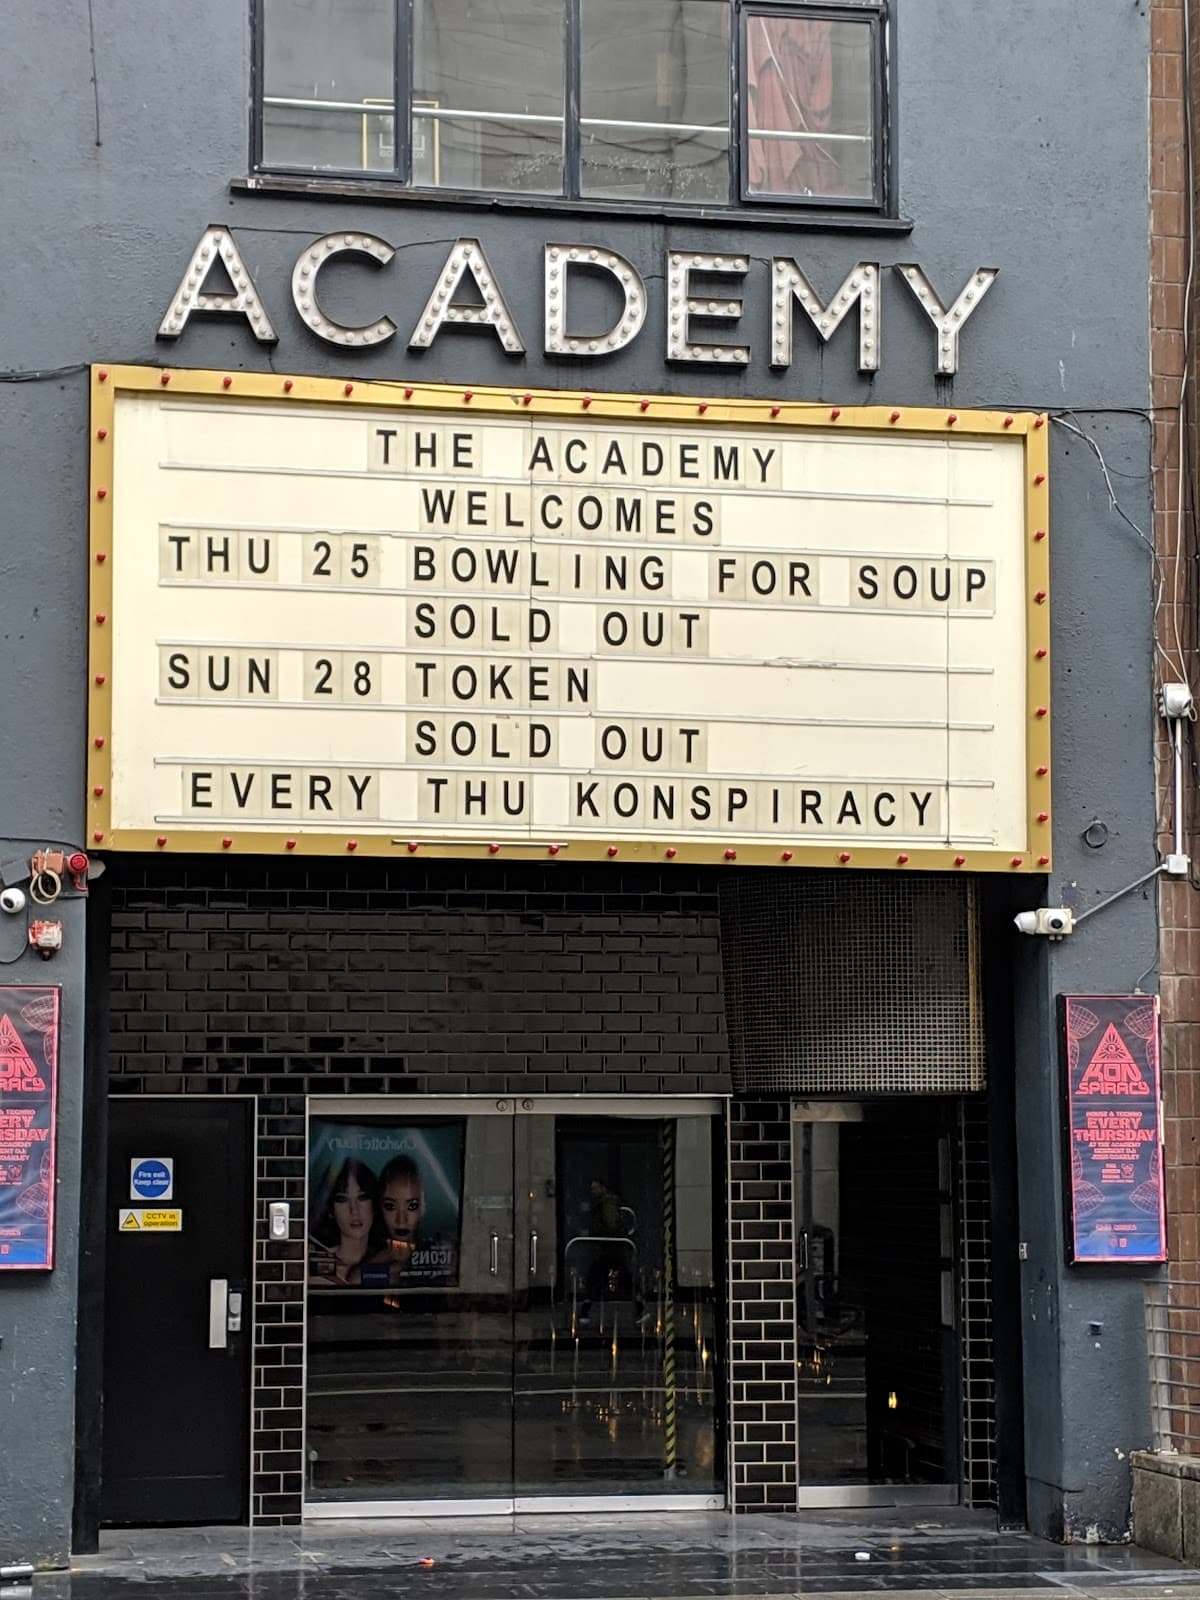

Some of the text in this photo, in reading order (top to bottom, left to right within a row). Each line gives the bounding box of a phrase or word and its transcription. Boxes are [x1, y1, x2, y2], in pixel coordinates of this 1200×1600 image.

[156, 225, 999, 376] ACADEMY
[376, 429, 775, 483] THE ACADEMY
[422, 488, 713, 536] WELCOMES
[168, 536, 986, 602] THU 25 BOWLING FOR SOUP
[414, 603, 700, 649] SOLD OUT
[168, 653, 588, 703] SUN 28 TOKEN
[415, 720, 700, 763] SOLD OUT
[191, 772, 932, 827] EVERY THU KONSPIRACY
[1075, 1082, 1150, 1095] SPIRACY
[1082, 1064, 1142, 1082] KON
[0, 1128, 49, 1141] SDAY
[1073, 1129, 1155, 1141] THURSDAY
[1087, 1117, 1141, 1129] EVERY
